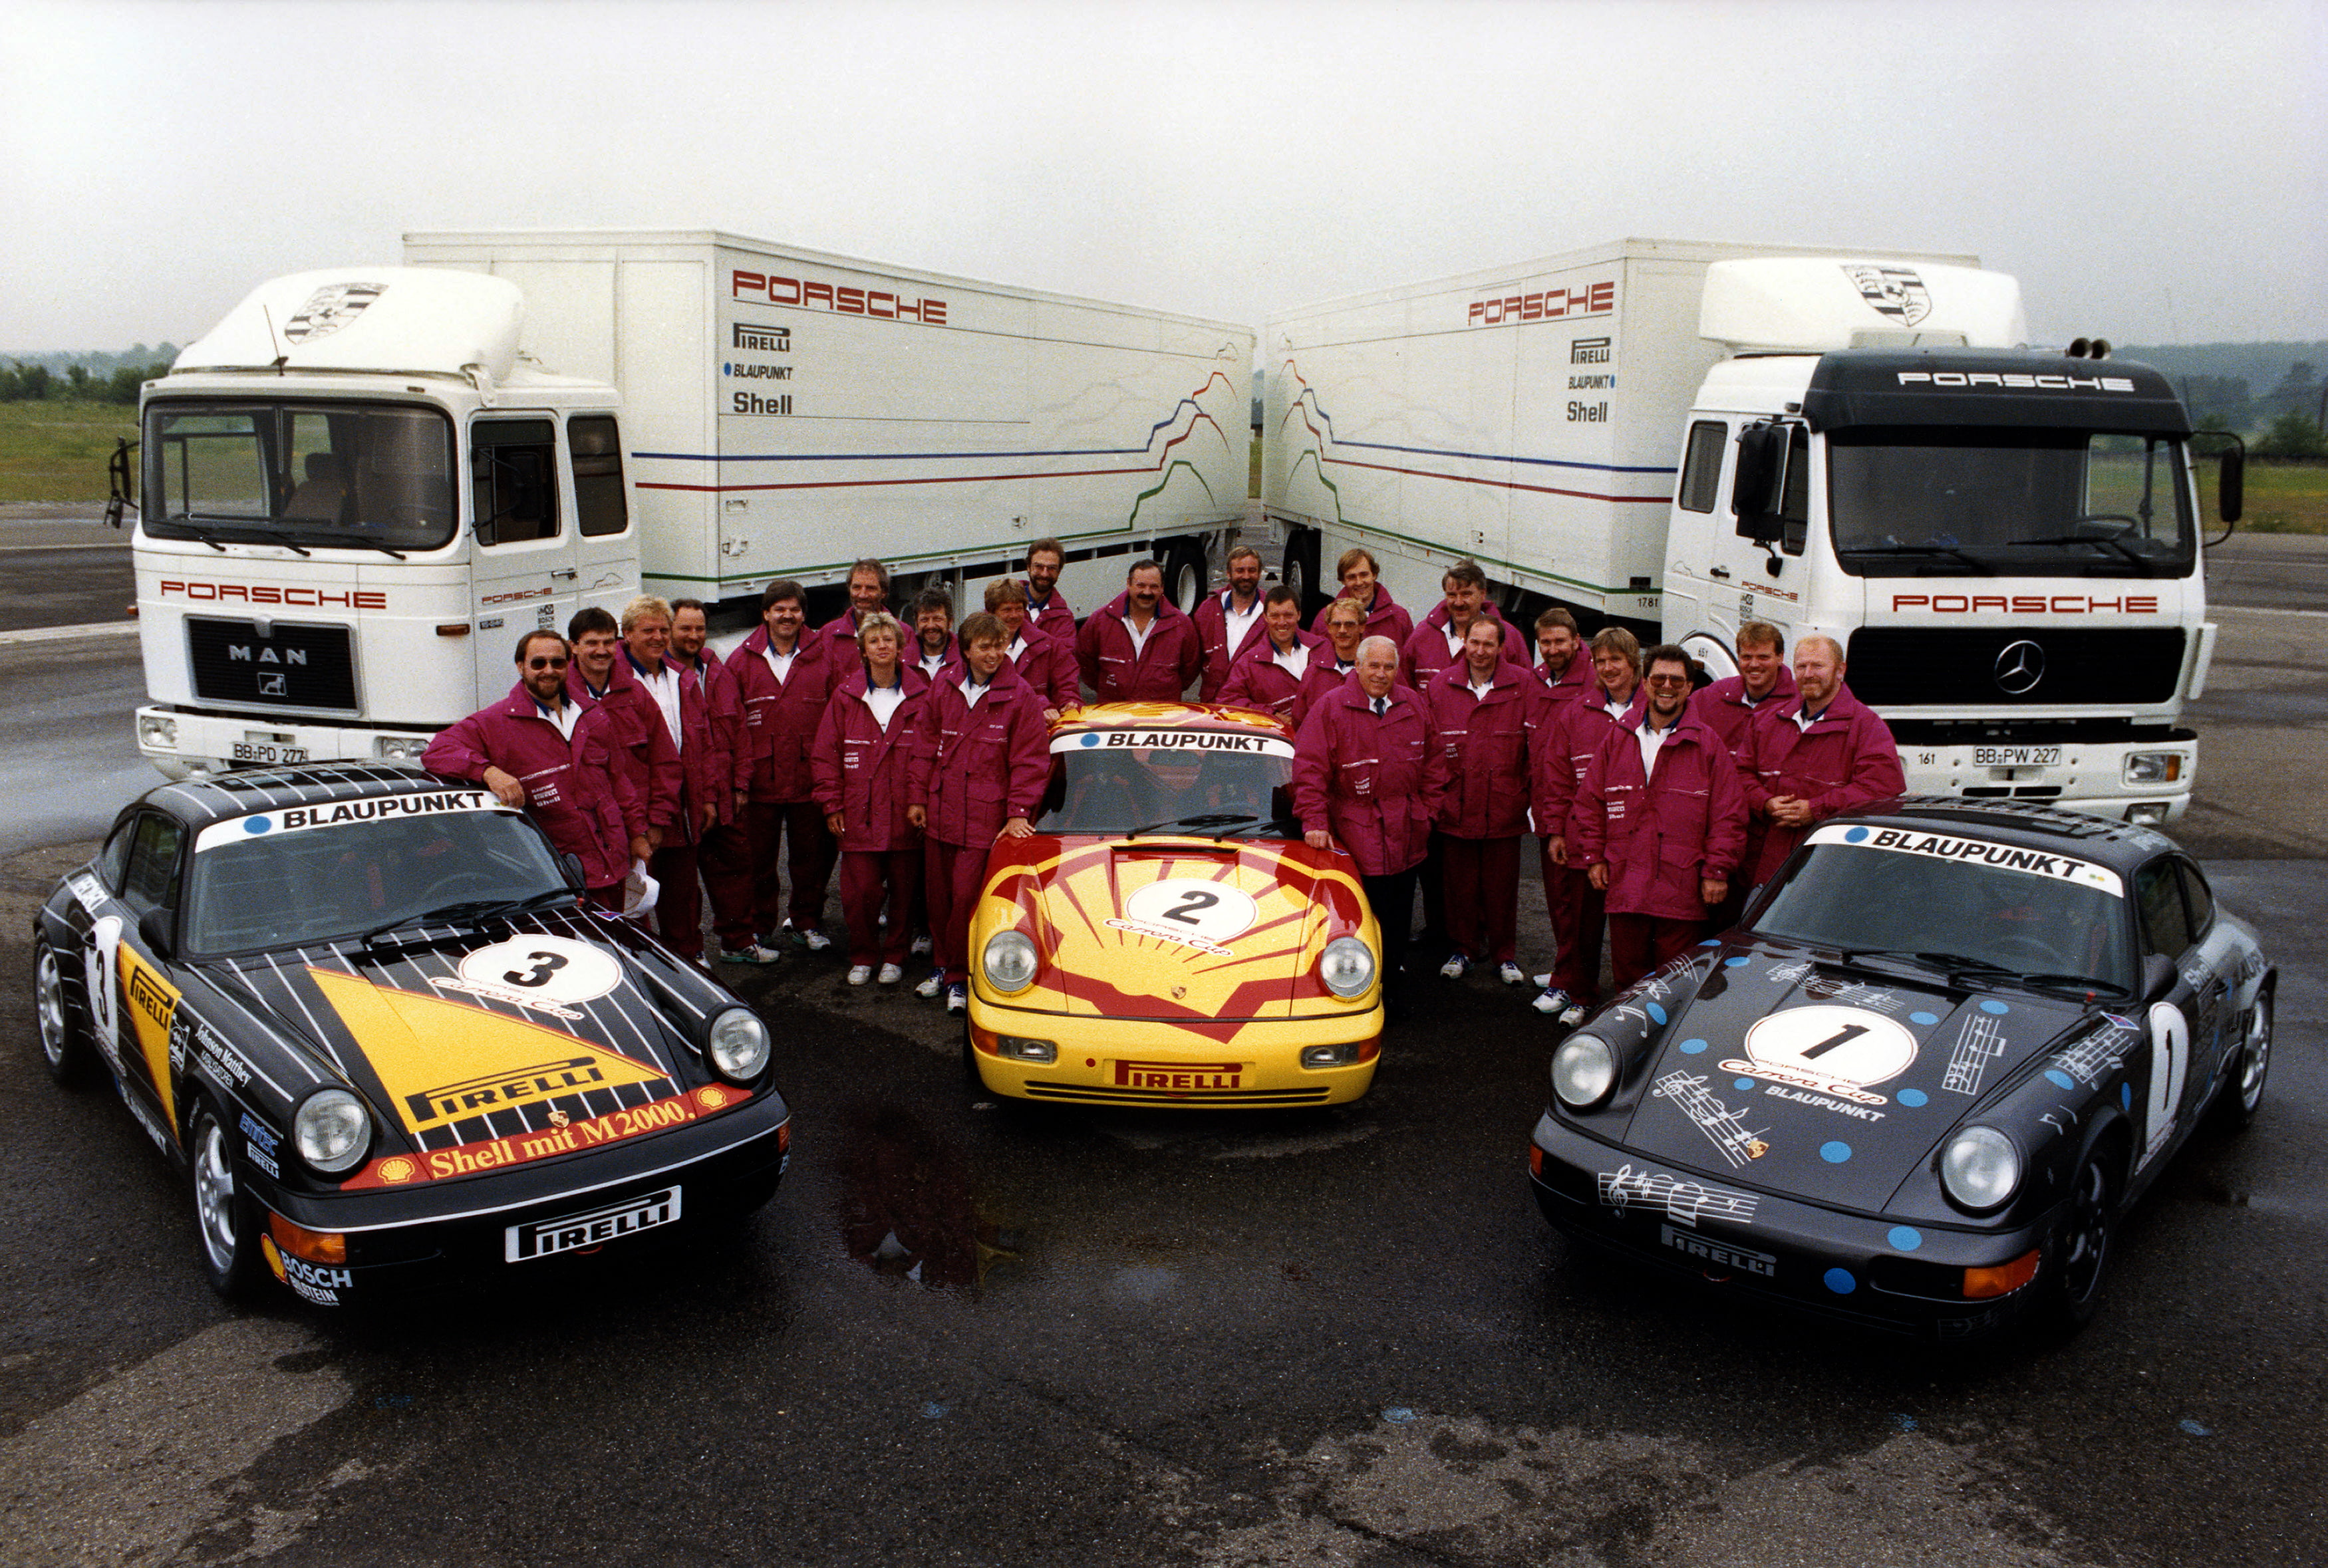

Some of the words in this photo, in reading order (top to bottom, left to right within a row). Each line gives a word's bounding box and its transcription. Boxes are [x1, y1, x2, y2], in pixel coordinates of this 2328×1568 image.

[733, 270, 946, 325] PORSCHE
[1469, 281, 1614, 326] PORSCHE
[734, 323, 790, 352] PIRELLI
[1570, 336, 1611, 364] PIRELLI
[734, 364, 792, 380] BLAUPUNKT
[1568, 375, 1609, 389] BLAUPUNKT
[1898, 372, 2134, 391] PORSCHE
[734, 391, 792, 414] Shell
[1567, 401, 1608, 422] Shell
[161, 581, 386, 610] PORSCHE
[482, 587, 552, 604] PORSCHE
[1741, 581, 1798, 600] PORSCHE
[1893, 594, 2158, 613] PORSCHE
[229, 645, 307, 665] MAN
[1107, 733, 1270, 752] BLAUPUNKT
[2033, 748, 2059, 763] 227
[284, 791, 484, 830] BLAUPUNKT
[1872, 831, 2086, 879] BLAUPUNKT
[1162, 890, 1219, 926] 2
[1105, 919, 1182, 942] Carrera
[1188, 940, 1231, 956] Cup
[503, 951, 569, 987] 3
[96, 950, 108, 1027] 3
[130, 966, 174, 1031] PIRELLI
[432, 978, 523, 1003] Carrera
[531, 1001, 581, 1019] Cup
[195, 1023, 223, 1059] Johnson
[220, 1049, 252, 1087] Matthey
[1800, 1024, 1871, 1059] 1
[1115, 1060, 1243, 1089] PIRELLI
[1721, 1061, 1819, 1088] Carrera
[1828, 1084, 1884, 1104] Cup
[2166, 1029, 2173, 1111] 1
[404, 1056, 604, 1124] PIRELLI
[1765, 1085, 1885, 1122] BLAUPUNKT
[247, 1140, 279, 1179] PIRELLI
[430, 1140, 517, 1178] Shell
[521, 1128, 578, 1158] mit
[518, 1190, 672, 1259] PIRELLI
[1662, 1224, 1777, 1277] PIRELLI
[281, 1250, 353, 1288] BOSCH
